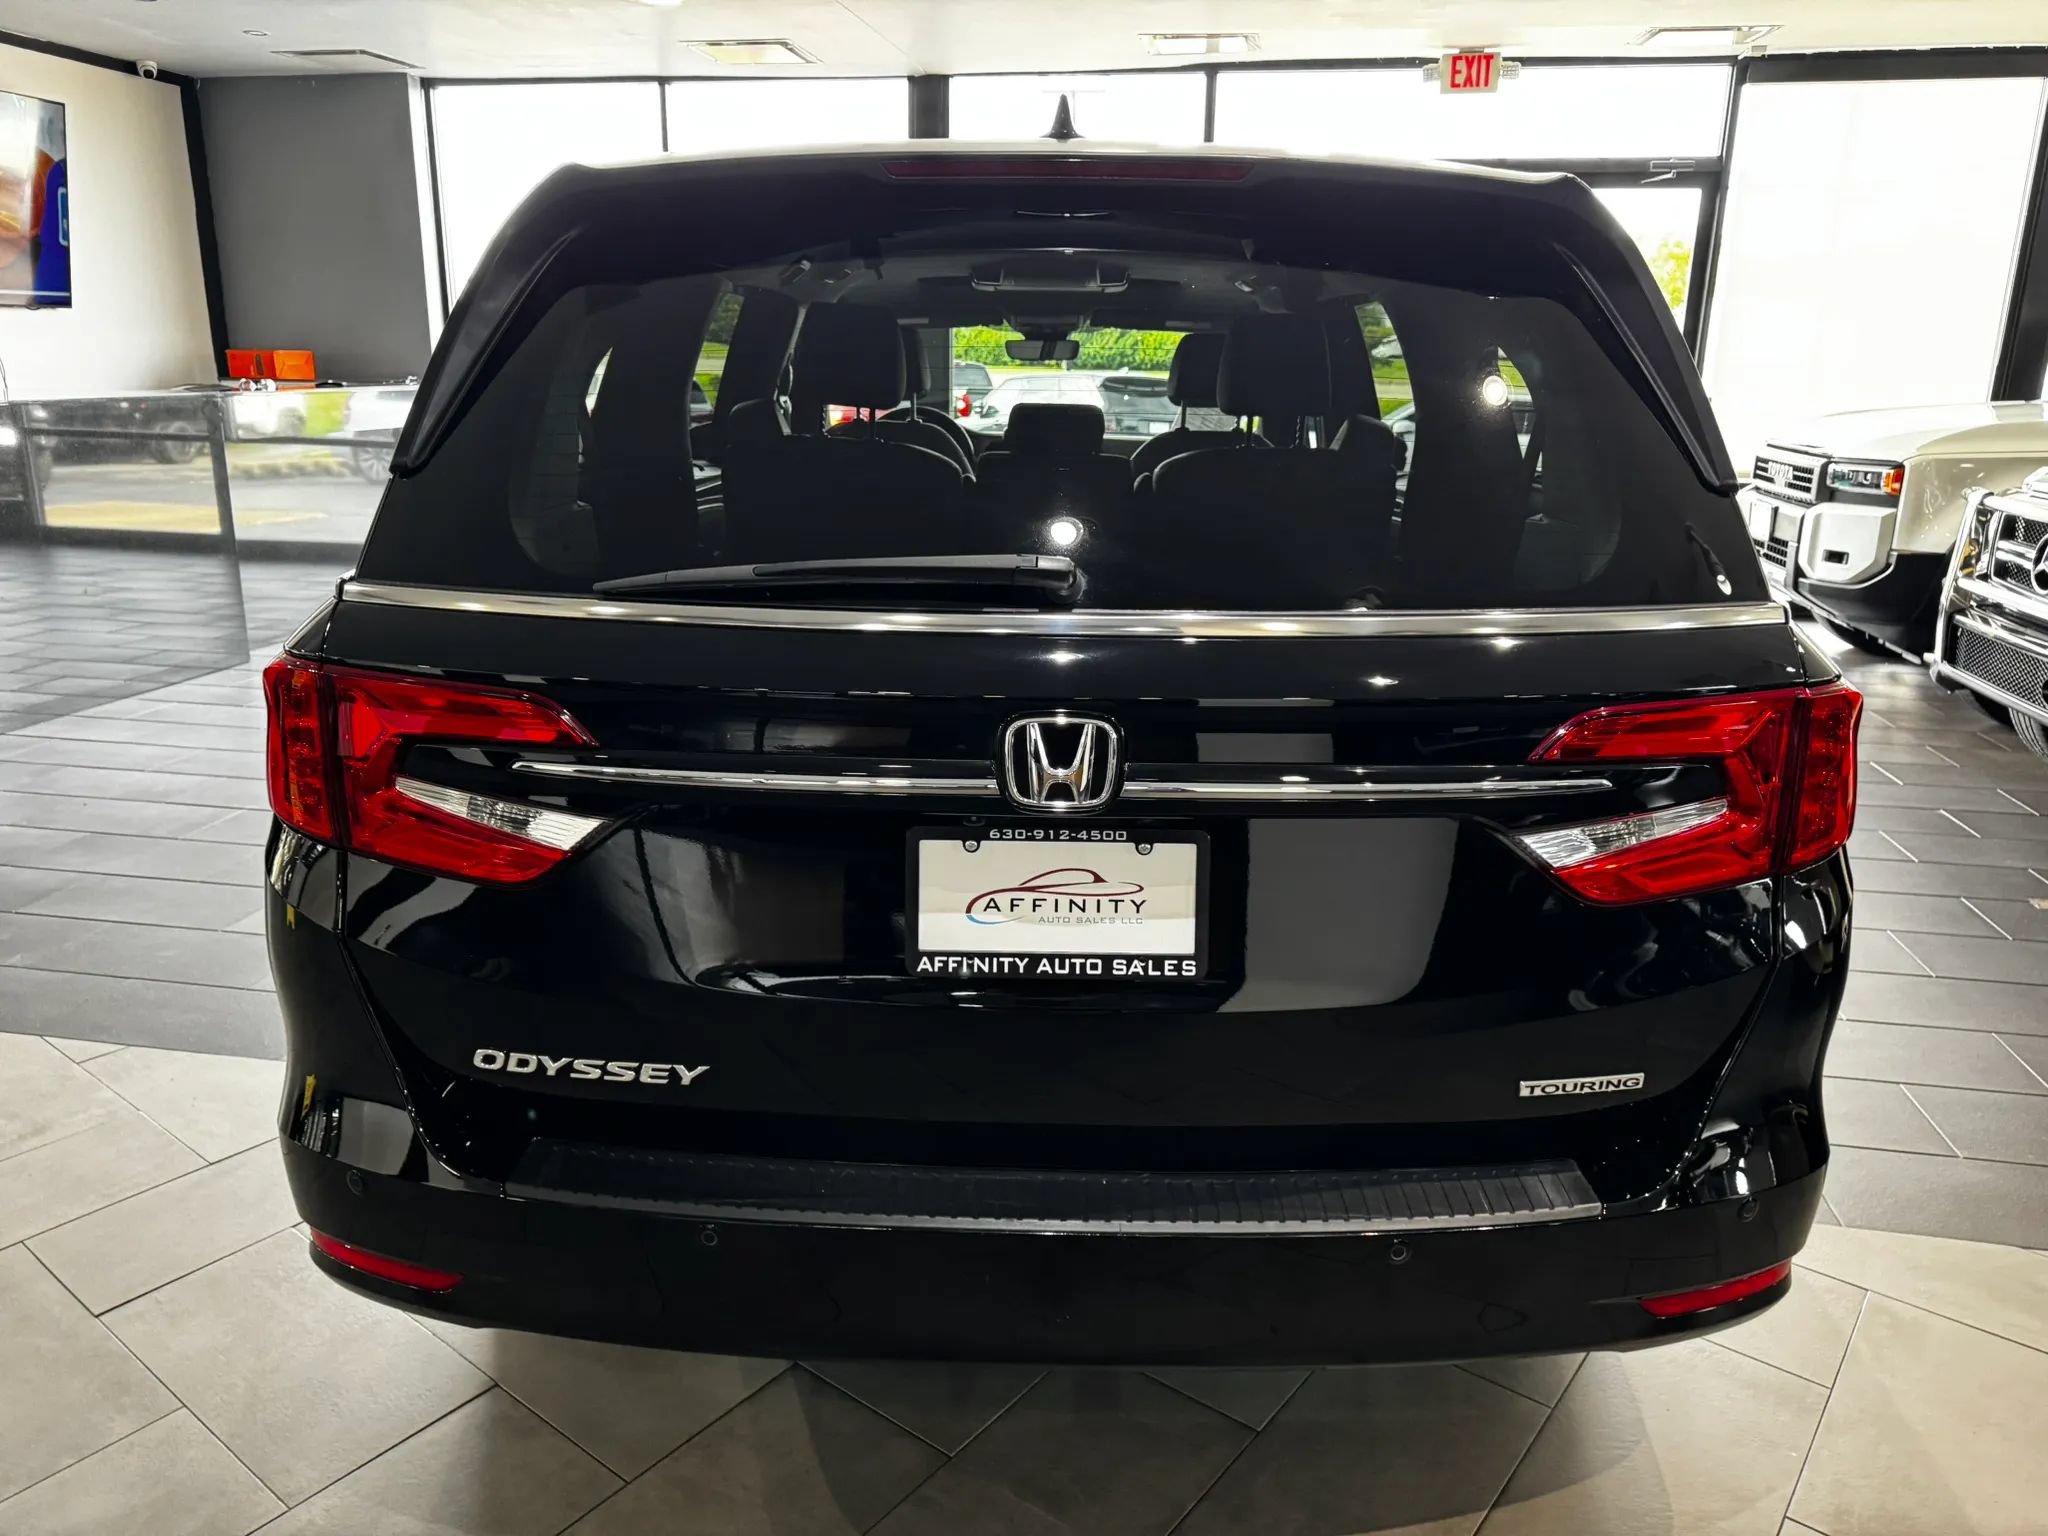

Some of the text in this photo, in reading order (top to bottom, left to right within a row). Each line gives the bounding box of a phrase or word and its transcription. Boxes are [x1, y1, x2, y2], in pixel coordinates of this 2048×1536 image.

[1450, 54, 1494, 88] EXIT
[989, 829, 1127, 841] 630-912-4500
[983, 898, 1147, 914] AFFINITY
[1038, 916, 1143, 925] AUTO SALES LLC
[917, 956, 1197, 976] AFFINITY AUTO SALES
[473, 1049, 710, 1085] ODYSSEY
[1525, 1077, 1640, 1095] TOURING
